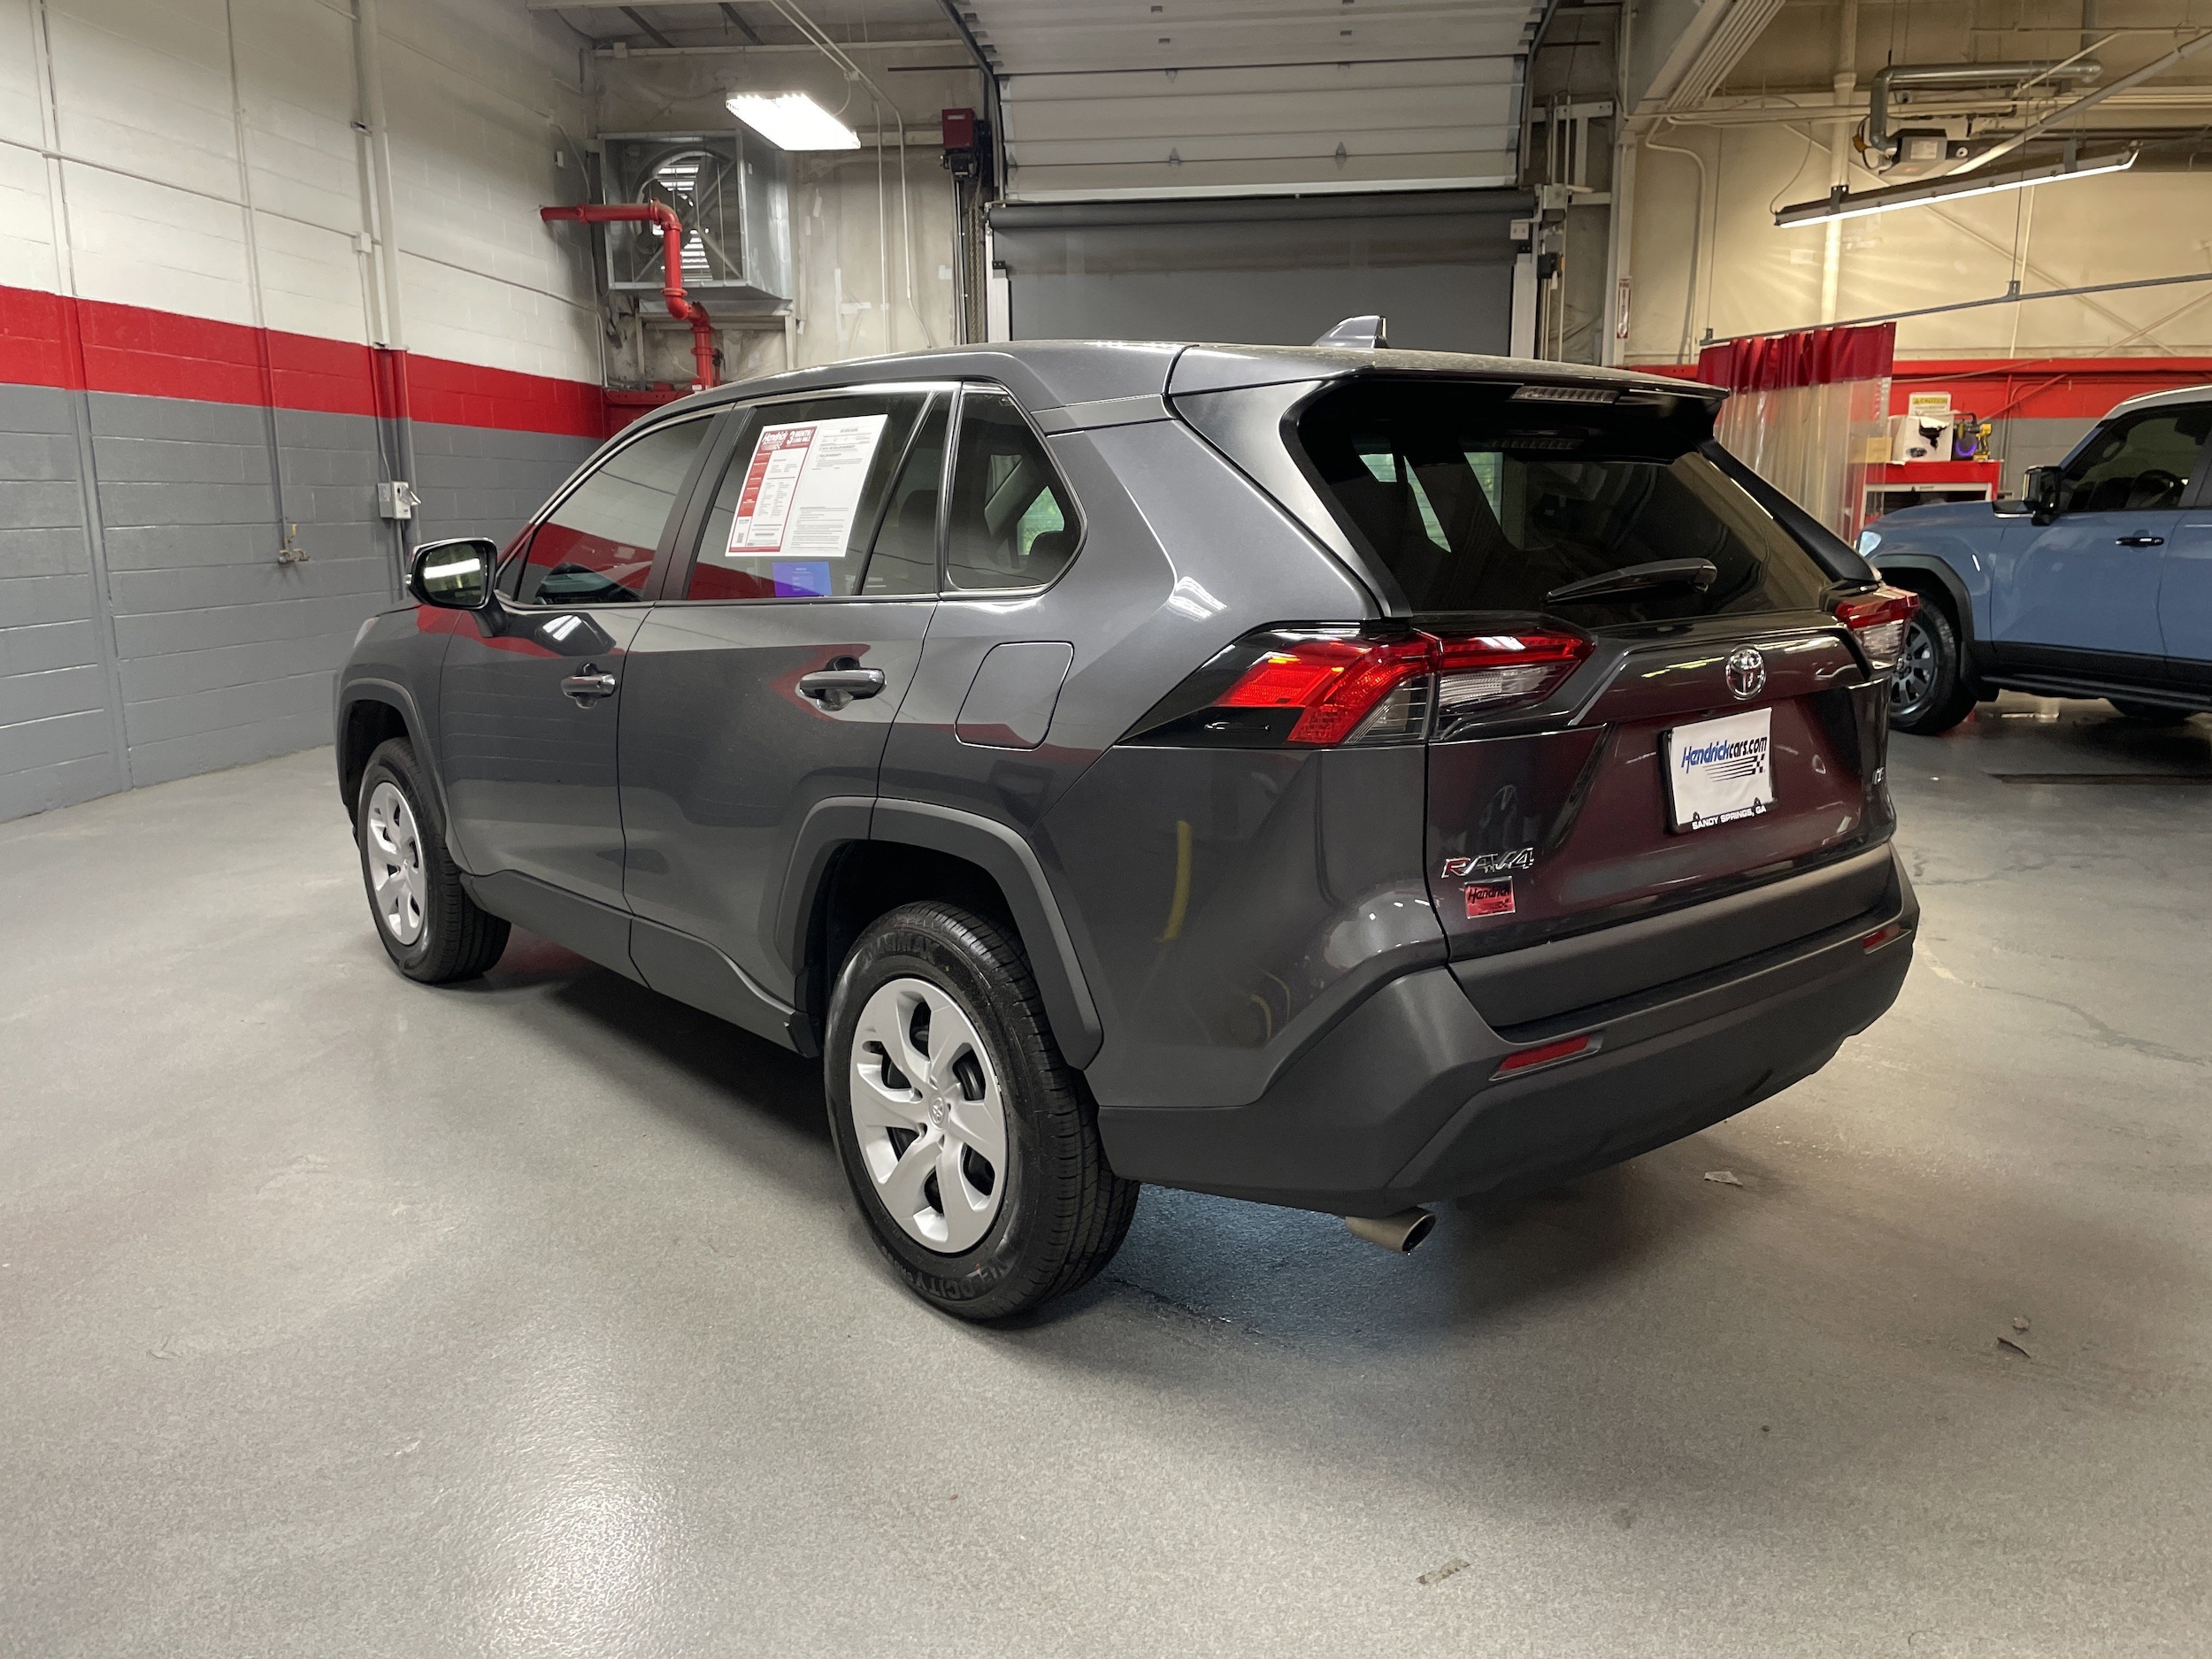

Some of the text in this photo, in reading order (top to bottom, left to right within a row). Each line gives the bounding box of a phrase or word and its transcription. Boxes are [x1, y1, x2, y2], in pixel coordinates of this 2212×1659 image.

[1681, 736, 1768, 774] Hendrickcars.com
[1692, 804, 1767, 830] SANDY SPRINGS, GA
[1440, 847, 1535, 879] RAV4
[1468, 885, 1510, 903] Hendrick
